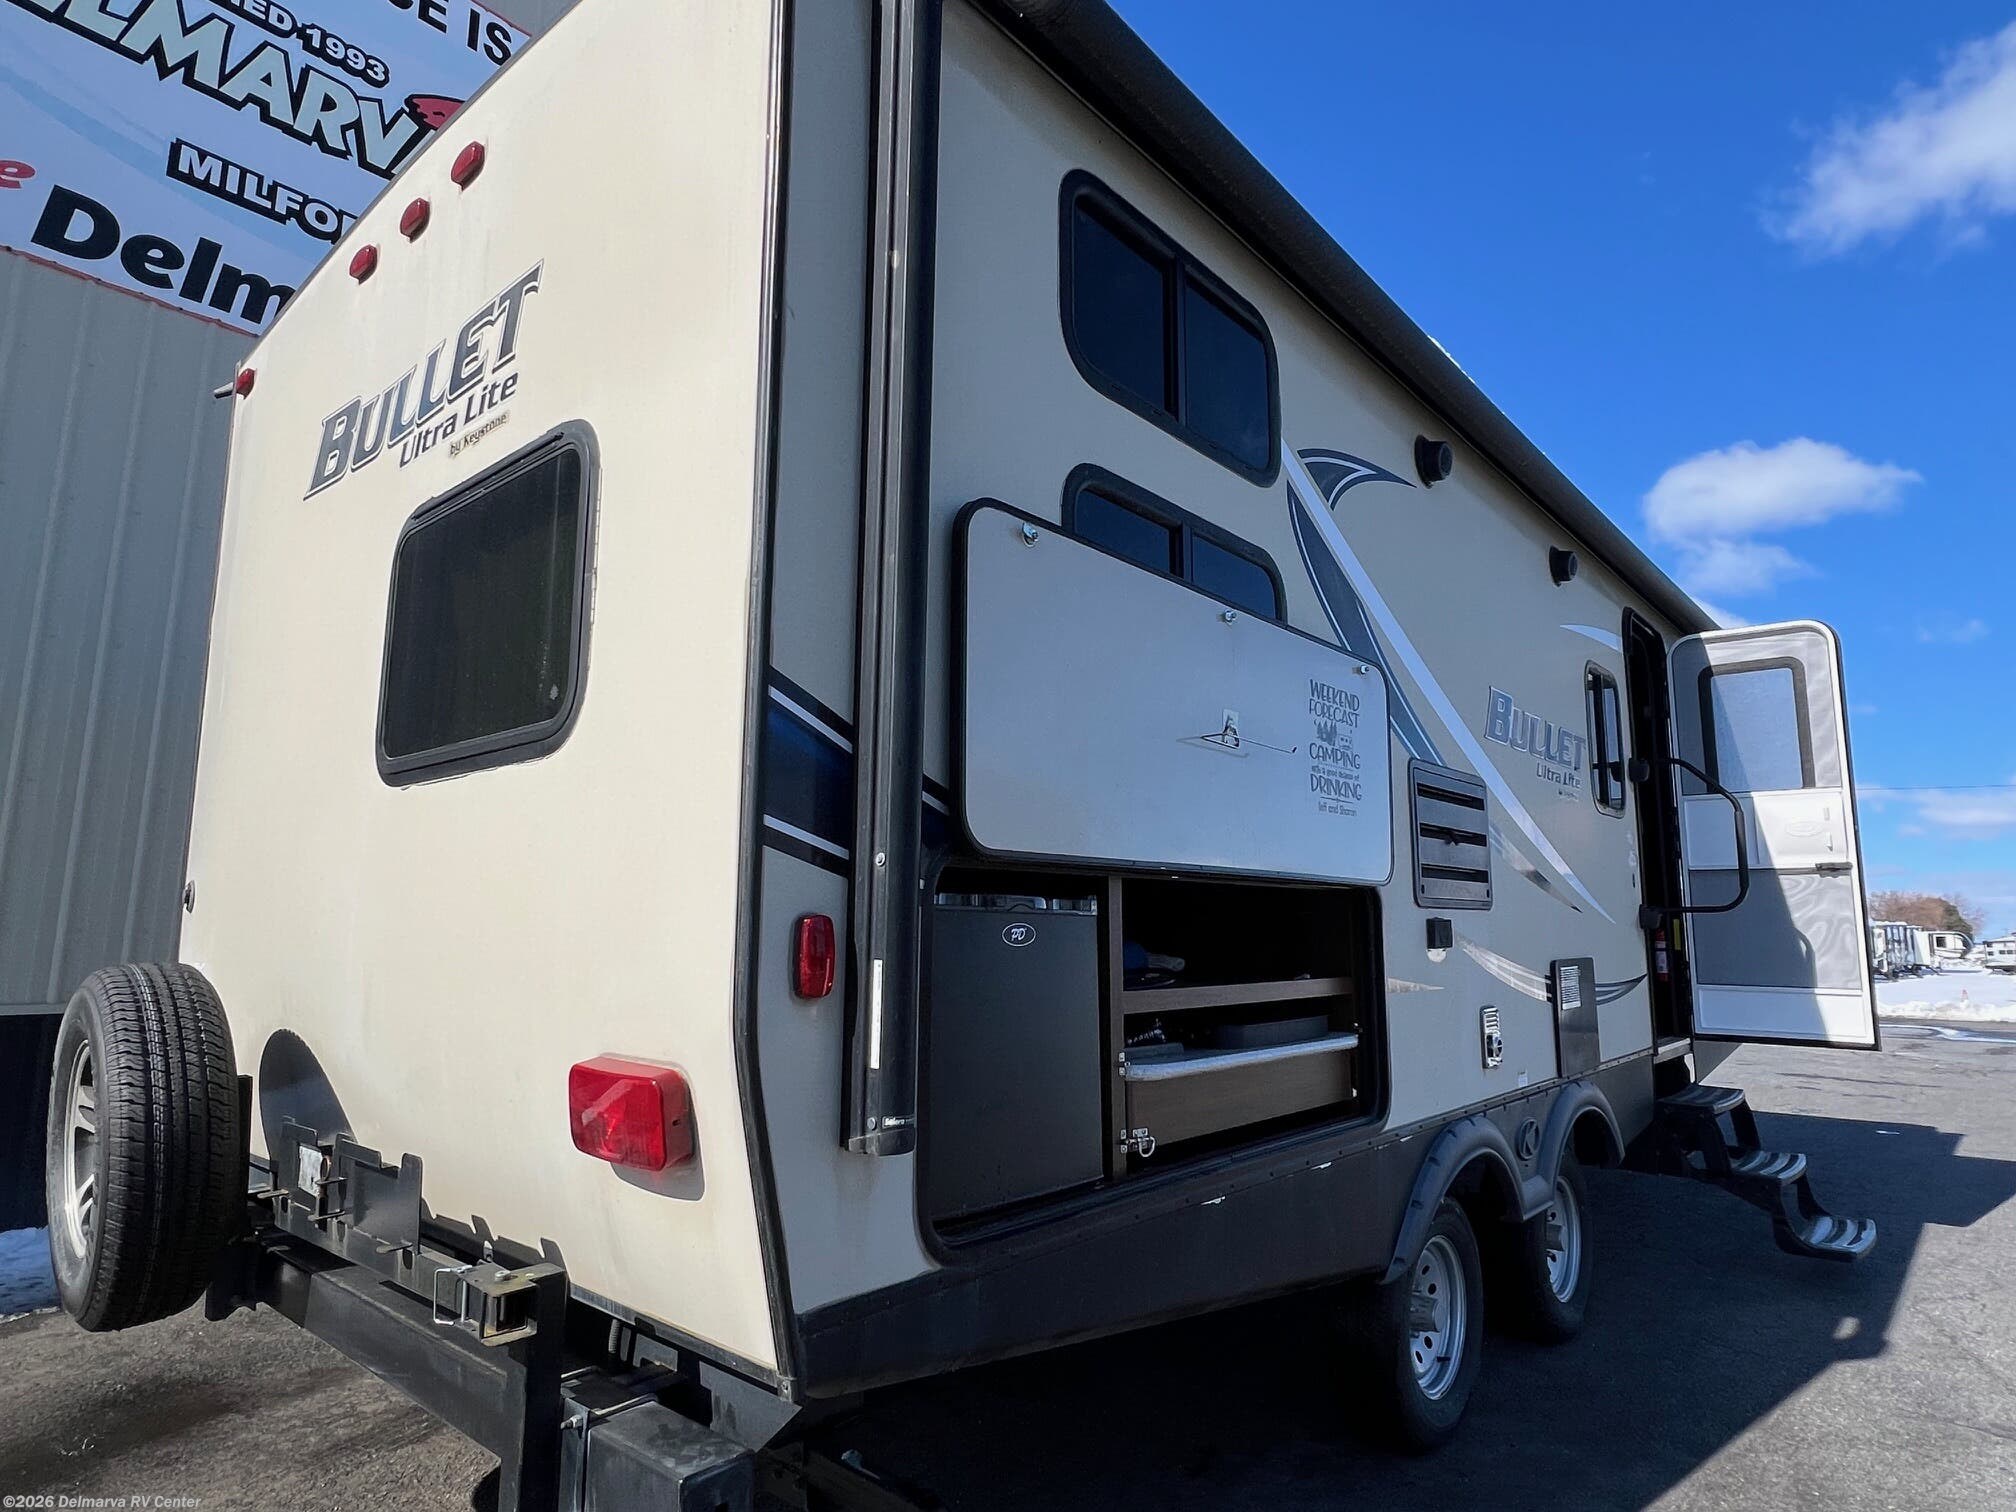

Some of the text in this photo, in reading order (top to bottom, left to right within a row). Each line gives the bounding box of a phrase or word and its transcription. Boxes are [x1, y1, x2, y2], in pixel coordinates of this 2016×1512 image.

[303, 23, 390, 88] 1993
[467, 8, 512, 66] IS
[166, 137, 353, 244] MILFO
[303, 258, 544, 501] BULLET
[399, 371, 519, 468] Ultra Lite
[1309, 698, 1360, 728] FORECAST
[1310, 679, 1360, 711] WEEKEND
[1309, 742, 1361, 770] CAMPING
[1484, 686, 1587, 771] BULLET
[1310, 774, 1362, 801] DRINKING
[1536, 762, 1581, 789] Ultra Lite
